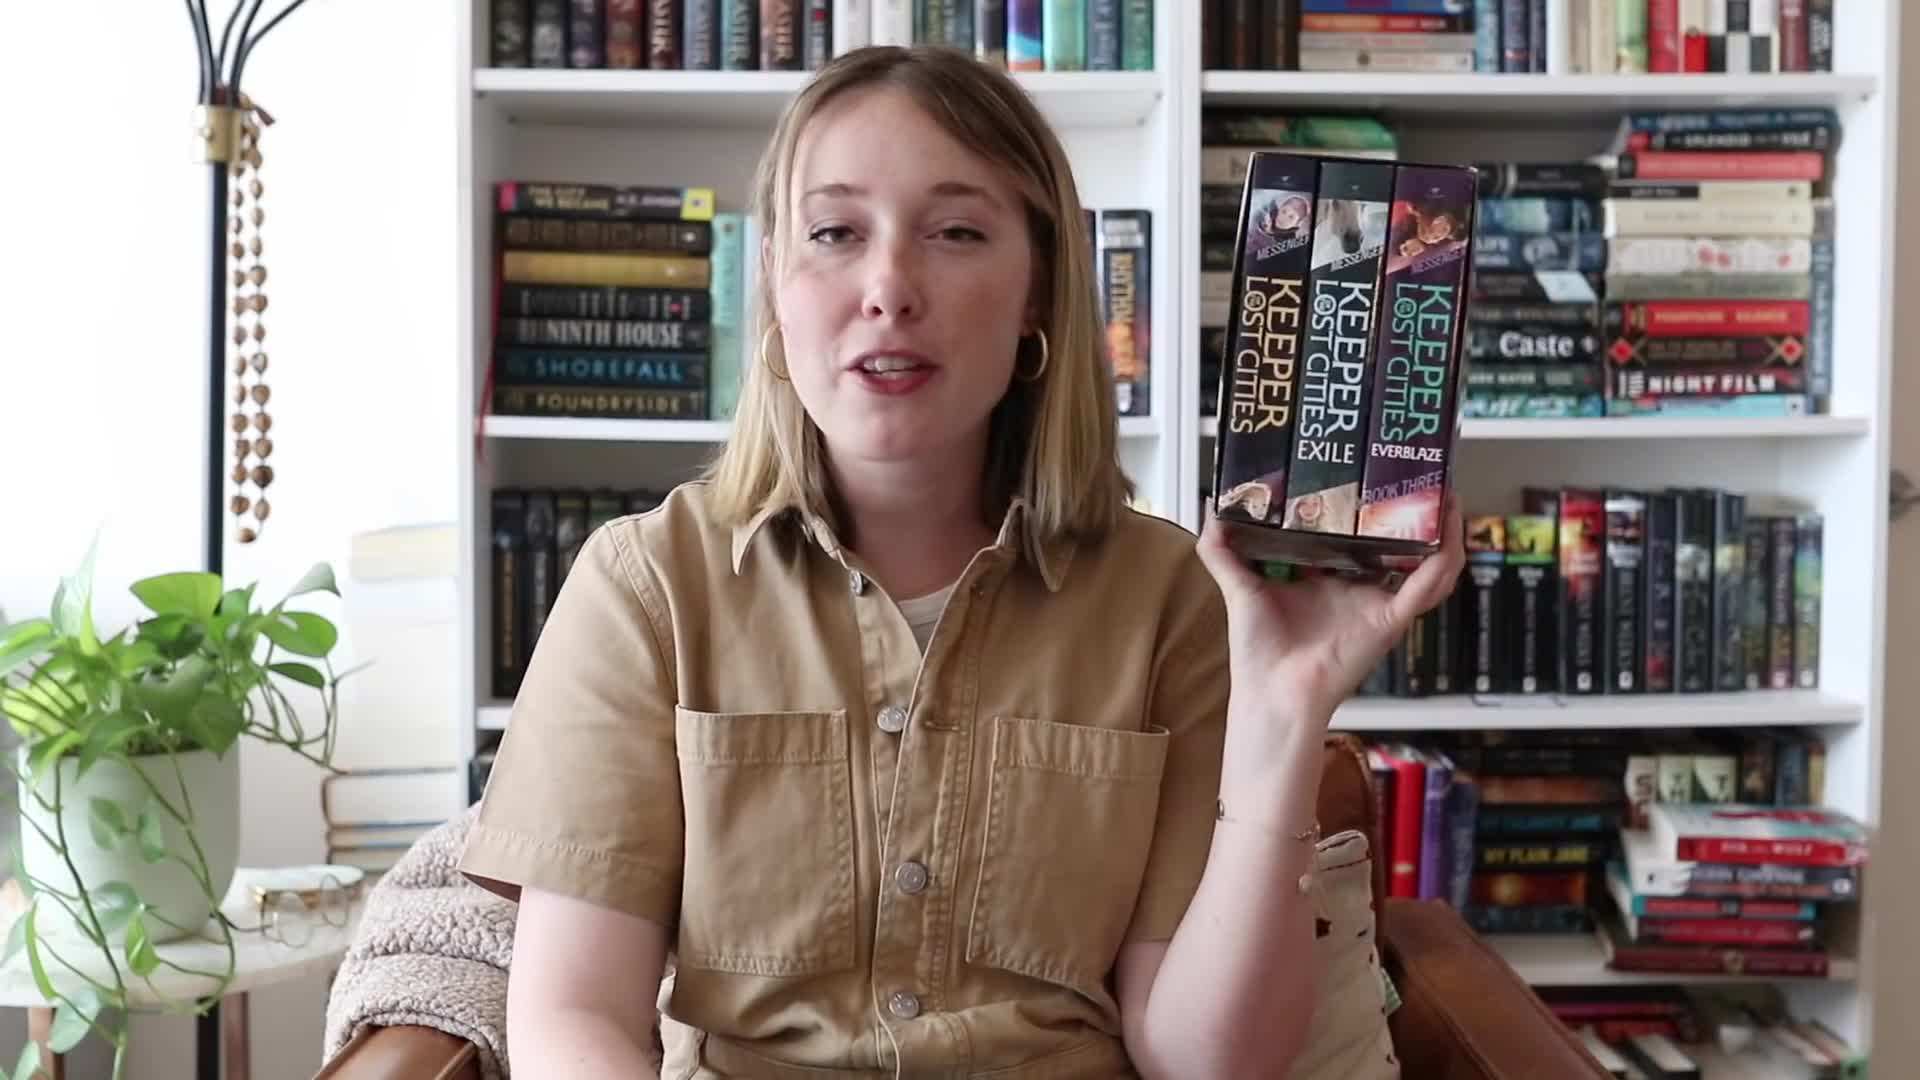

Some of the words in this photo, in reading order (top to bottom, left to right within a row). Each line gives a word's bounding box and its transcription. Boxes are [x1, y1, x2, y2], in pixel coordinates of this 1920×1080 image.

[547, 320, 611, 345] NINTH
[616, 322, 683, 347] HOUSE
[1240, 276, 1269, 347] LOST
[1310, 279, 1339, 352] LOST
[1389, 283, 1419, 355] LOST
[1499, 330, 1575, 358] Caste
[535, 357, 683, 381] SHOREFALL
[1254, 278, 1303, 433] KEEPER
[1323, 281, 1373, 438] KEEPER
[1405, 285, 1454, 441] KEEPER
[1648, 375, 1717, 393] NIGHT
[1720, 373, 1776, 393] FILM
[1229, 349, 1260, 434] CITIES
[1299, 353, 1330, 438] CITIES
[1379, 356, 1410, 442] CITIES
[1297, 439, 1355, 465] EXILE
[1362, 482, 1399, 504] BOOK
[1401, 470, 1443, 498] THREE
[1371, 442, 1444, 463] EVERBLAZE
